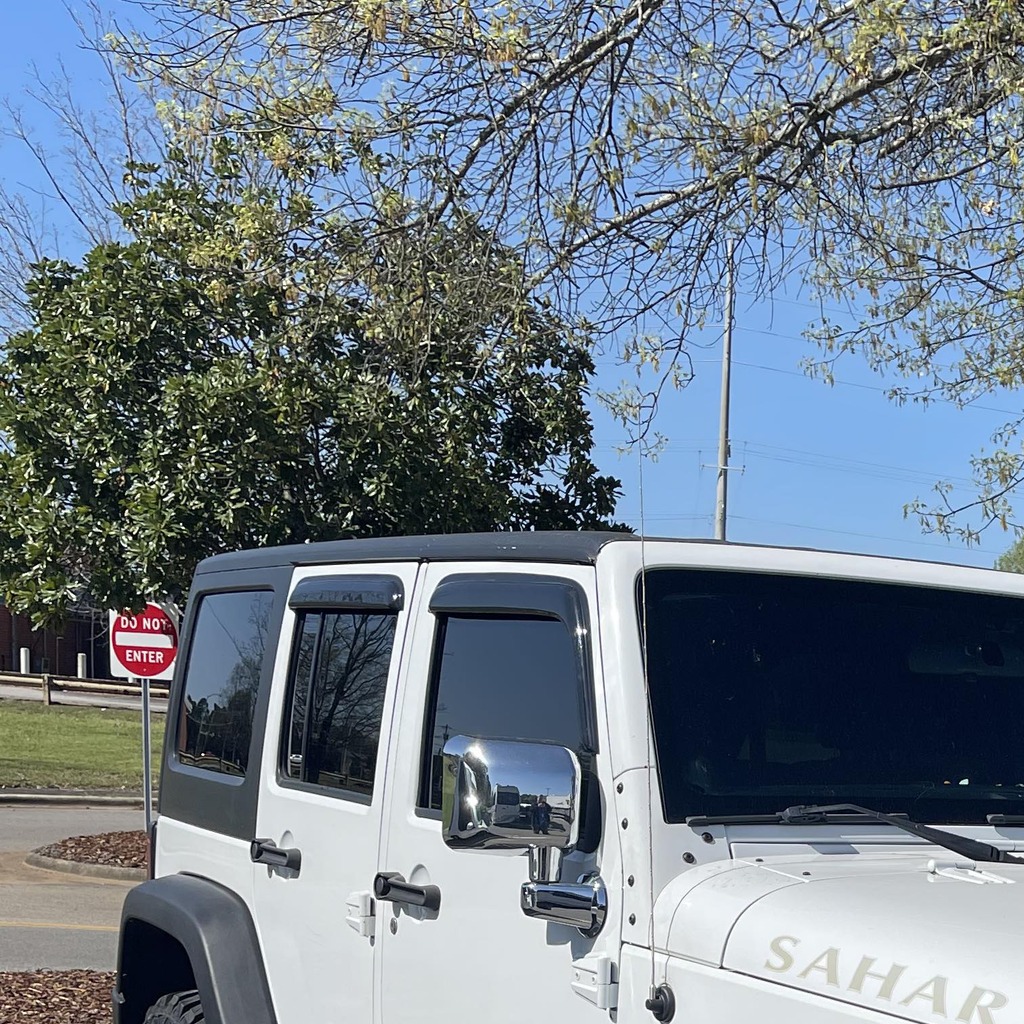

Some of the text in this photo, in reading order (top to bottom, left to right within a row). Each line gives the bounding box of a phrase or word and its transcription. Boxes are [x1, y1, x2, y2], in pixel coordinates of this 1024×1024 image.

[121, 617, 168, 631] DO NOT
[125, 650, 164, 664] ENTER
